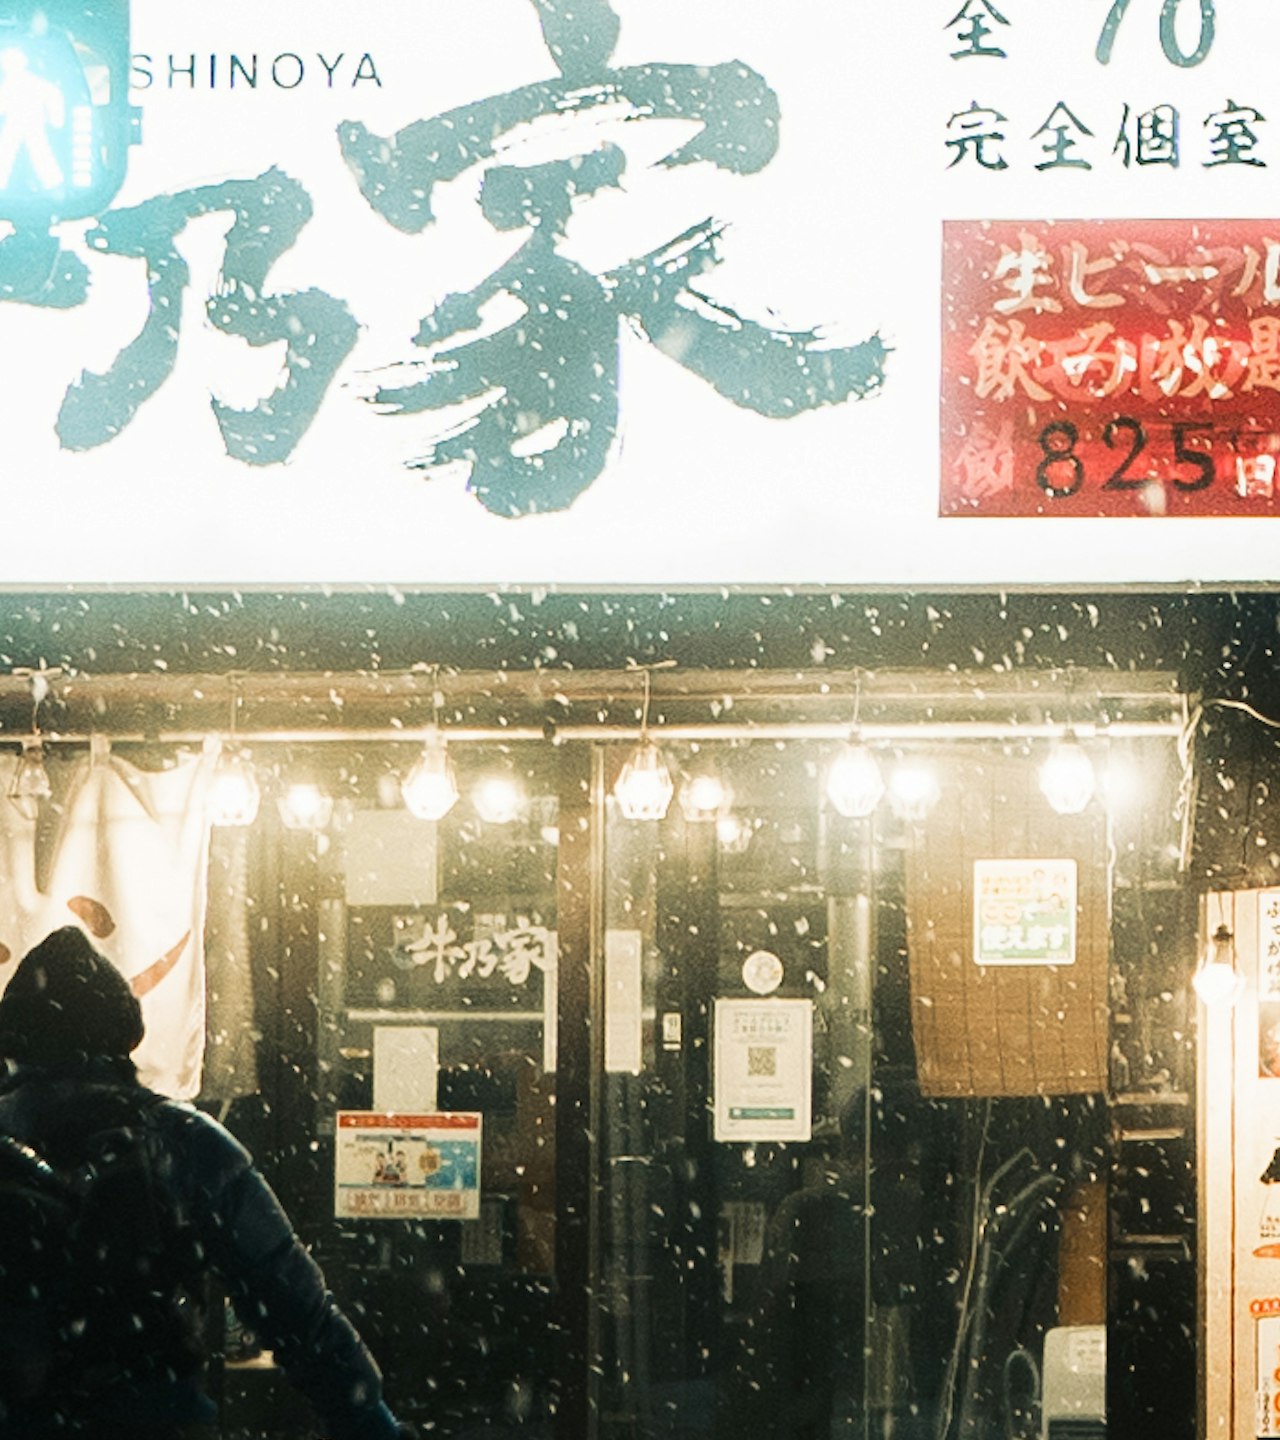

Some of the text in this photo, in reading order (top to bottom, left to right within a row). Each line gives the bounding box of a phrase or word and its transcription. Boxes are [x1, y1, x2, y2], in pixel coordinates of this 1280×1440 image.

[127, 50, 385, 92] SHINOYA
[402, 913, 556, 986] 牛乃家
